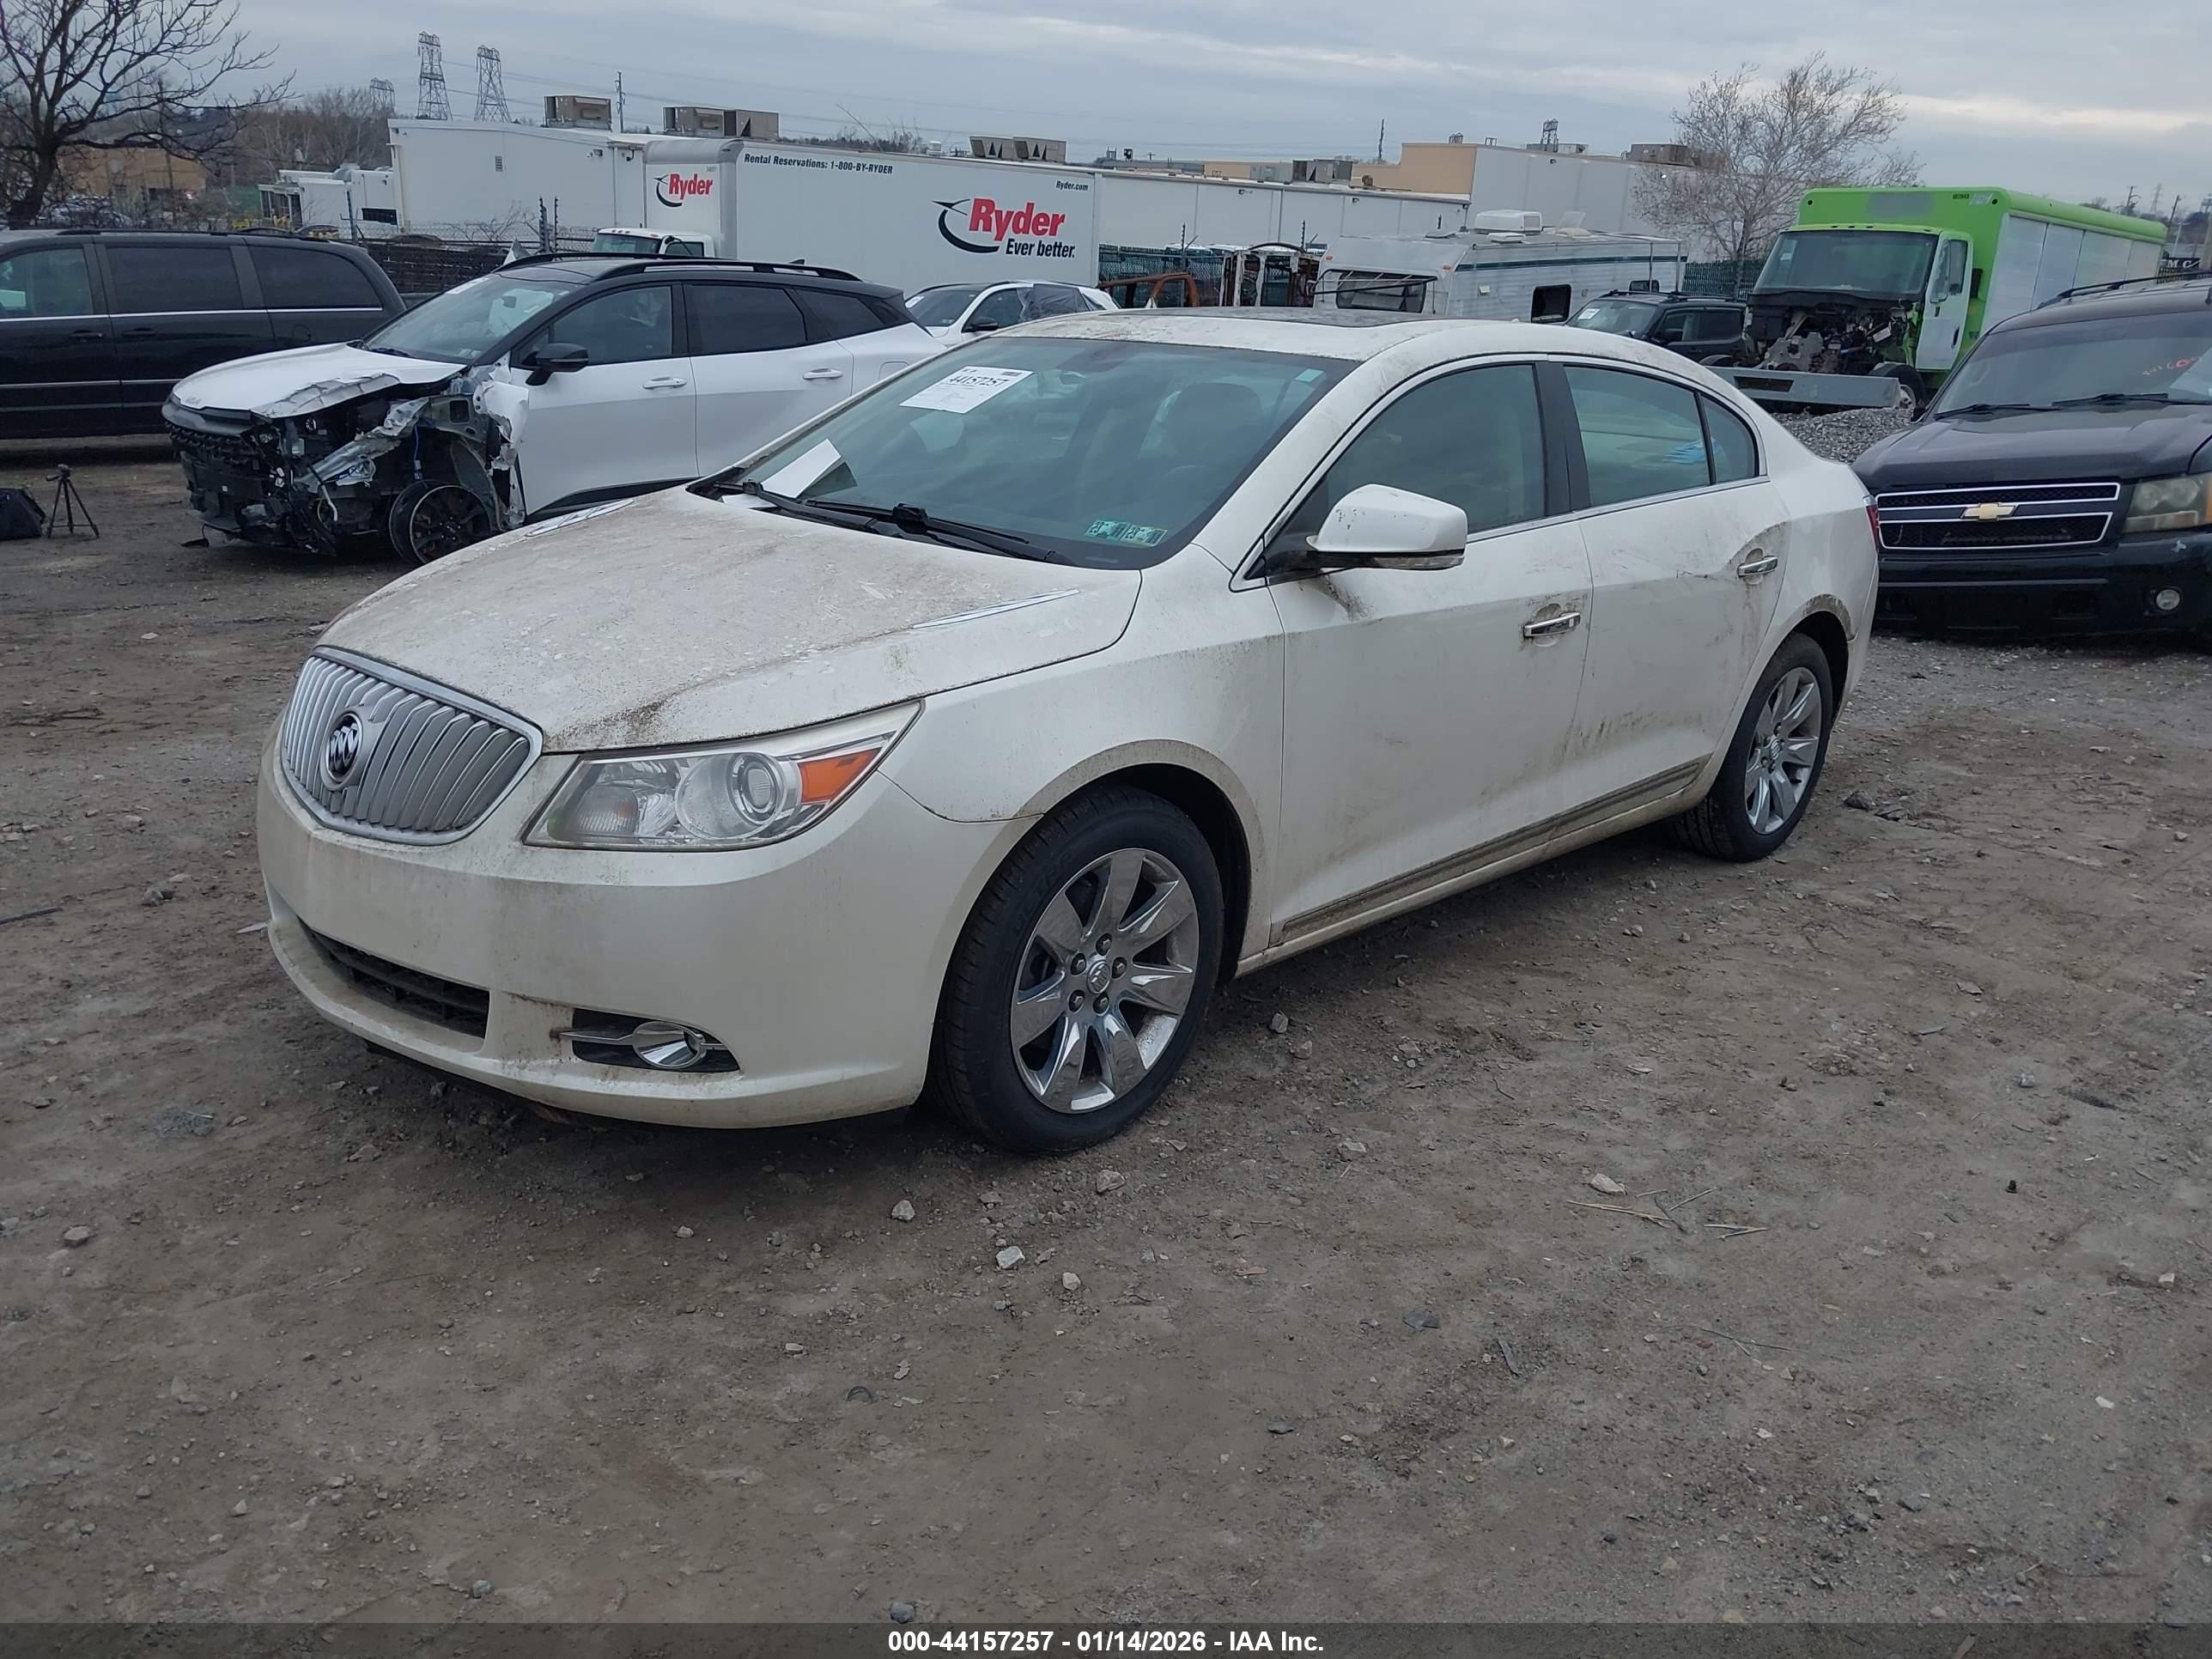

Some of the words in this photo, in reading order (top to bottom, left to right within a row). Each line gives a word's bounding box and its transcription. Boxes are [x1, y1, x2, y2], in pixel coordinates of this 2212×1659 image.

[744, 154, 770, 164] Rental
[773, 155, 828, 168] Reservations:
[830, 161, 893, 174] 1-800-BY-RYDER
[669, 173, 713, 200] Ryder
[1055, 179, 1089, 191] Ryder.com
[969, 198, 1066, 241] Ryder
[1006, 238, 1036, 256] Ever
[1036, 240, 1075, 258] better.
